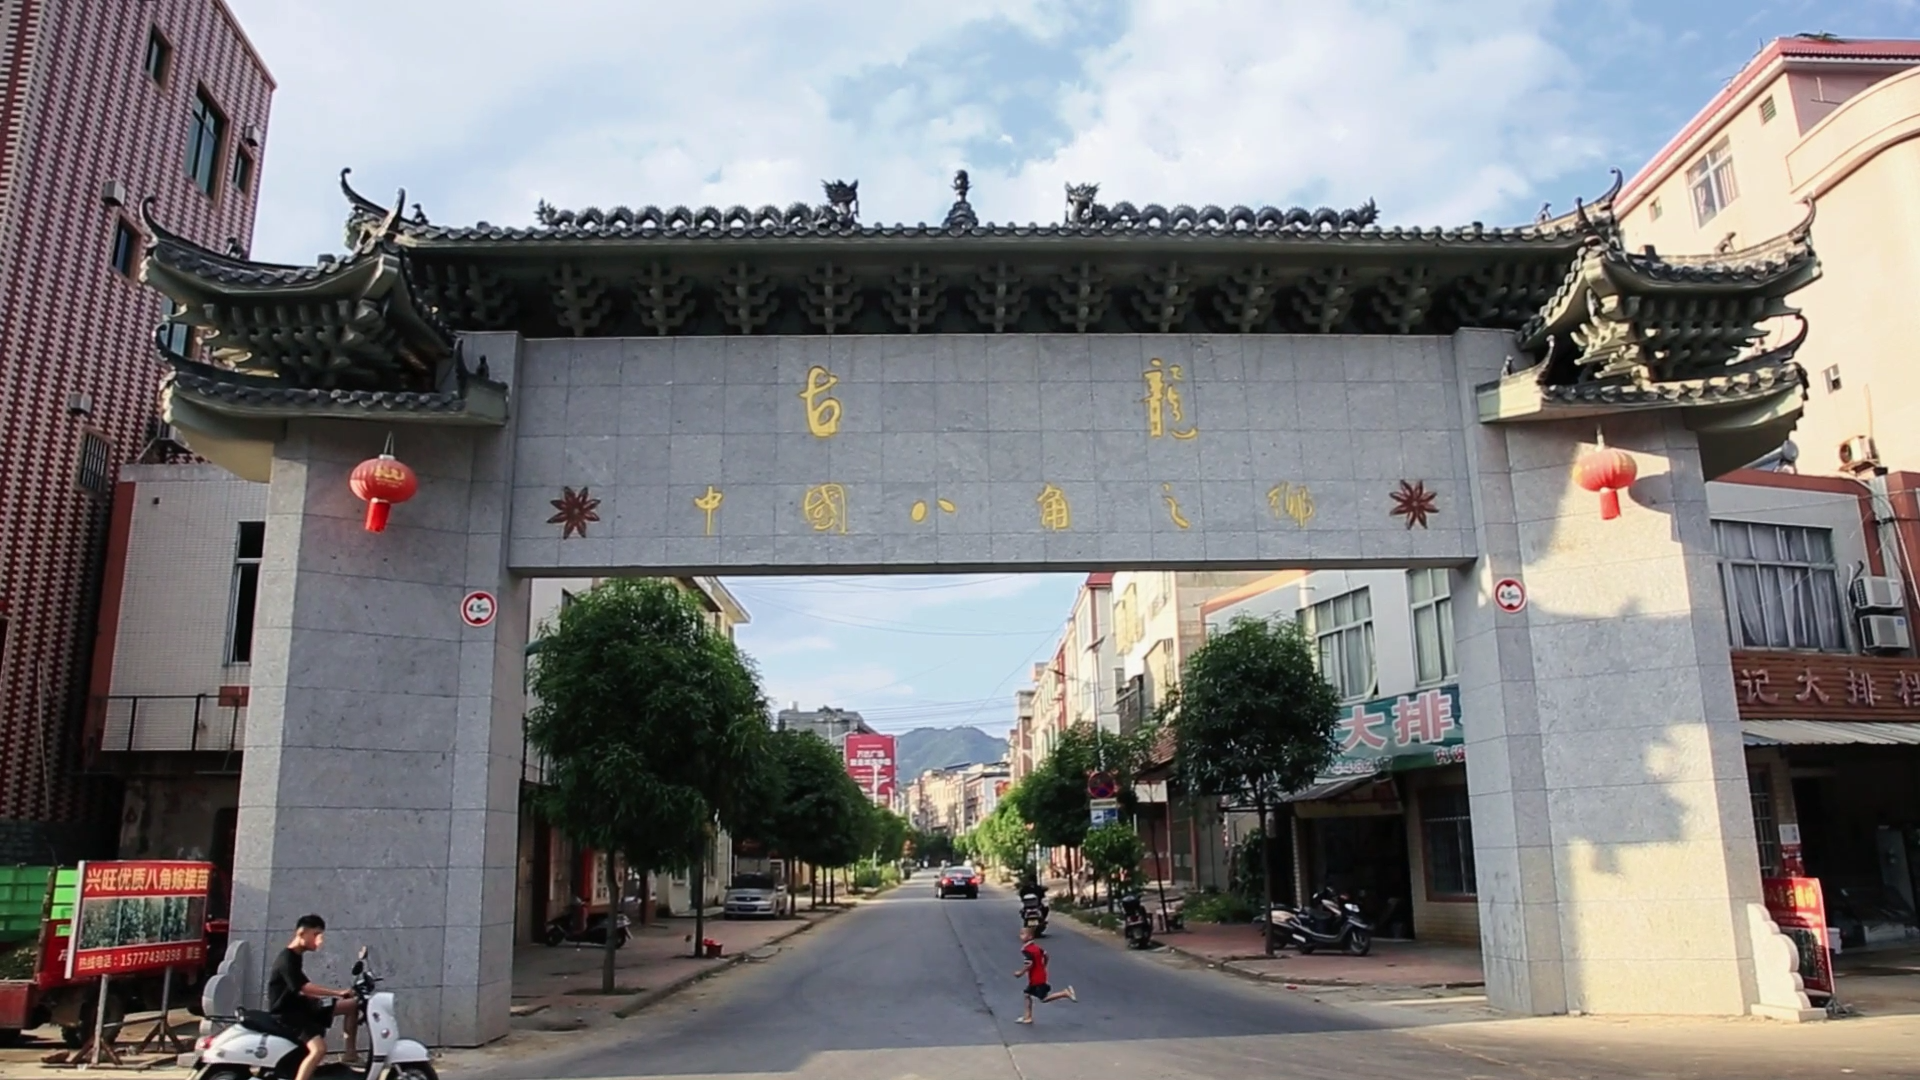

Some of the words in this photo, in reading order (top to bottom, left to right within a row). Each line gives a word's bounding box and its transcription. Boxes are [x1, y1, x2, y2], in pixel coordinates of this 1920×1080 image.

[85, 868, 209, 892] 兴旺优质八角嫁接苗
